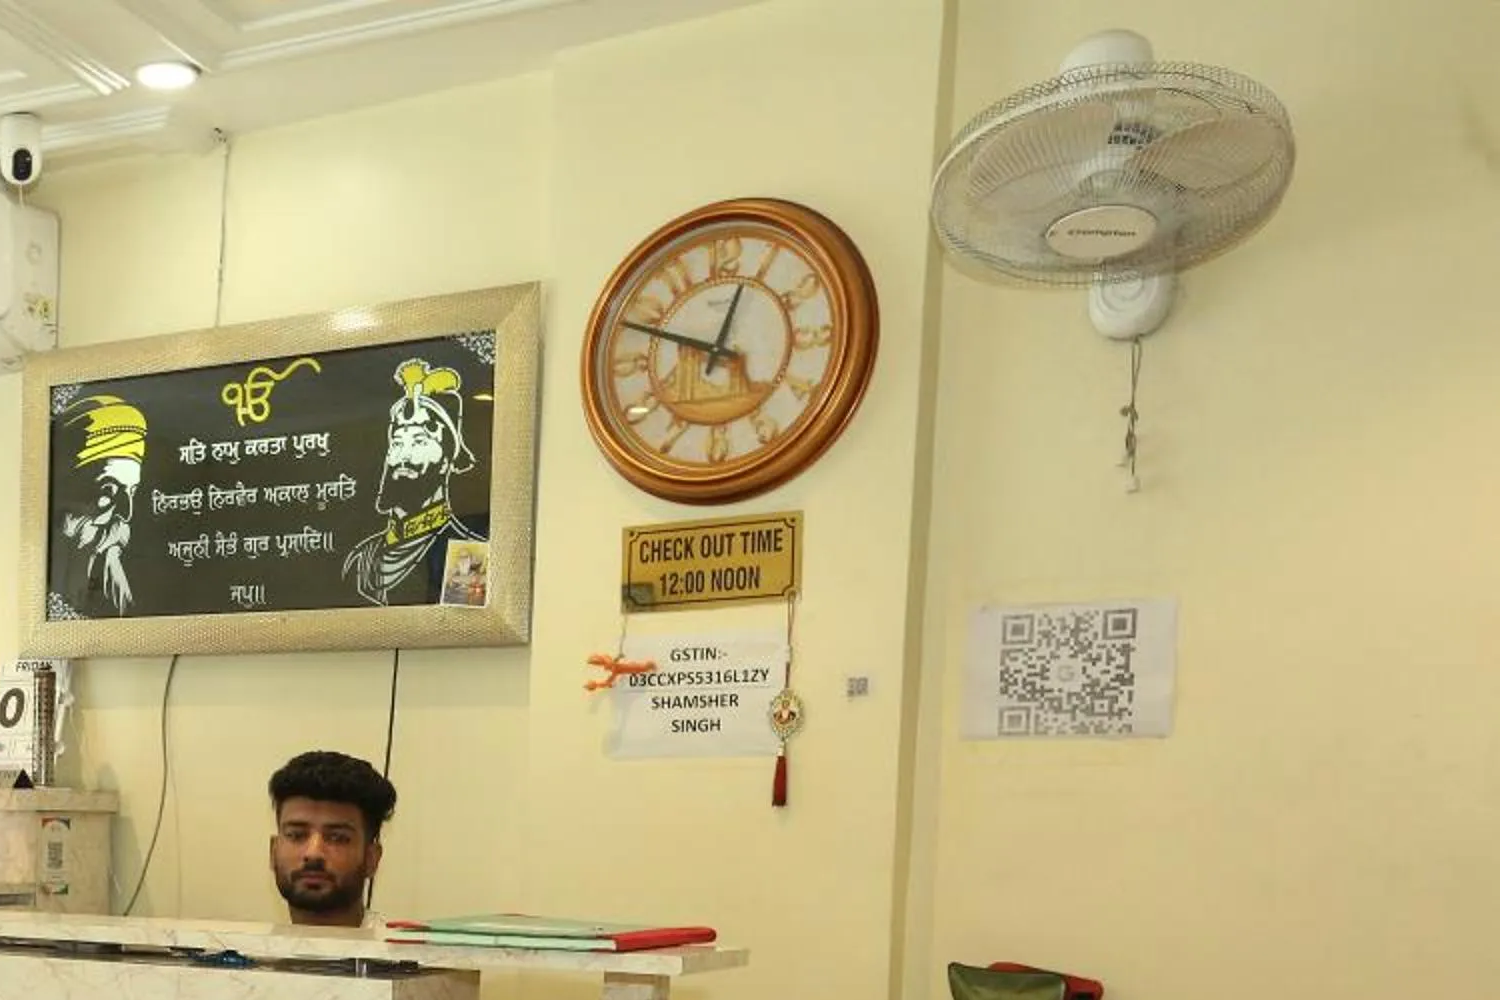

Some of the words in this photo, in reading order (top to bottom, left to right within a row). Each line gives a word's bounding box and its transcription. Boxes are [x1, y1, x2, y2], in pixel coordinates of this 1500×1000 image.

[179, 437, 207, 464] ਸਤਿ
[244, 436, 288, 457] ਕਰਤਾ
[263, 484, 310, 506] ਅਕਾਲ
[243, 535, 271, 559] ਗੁਰ
[639, 536, 695, 563] CHECK
[701, 532, 736, 559] OUT
[740, 528, 784, 555] TIME
[659, 569, 706, 597] 12:00
[711, 565, 761, 592] NOON
[670, 646, 728, 662] GSTIN:-
[629, 668, 770, 688] 03CCXPS5316L1ZY
[651, 693, 740, 710] SHAMSHER
[671, 719, 722, 733] SINGH
